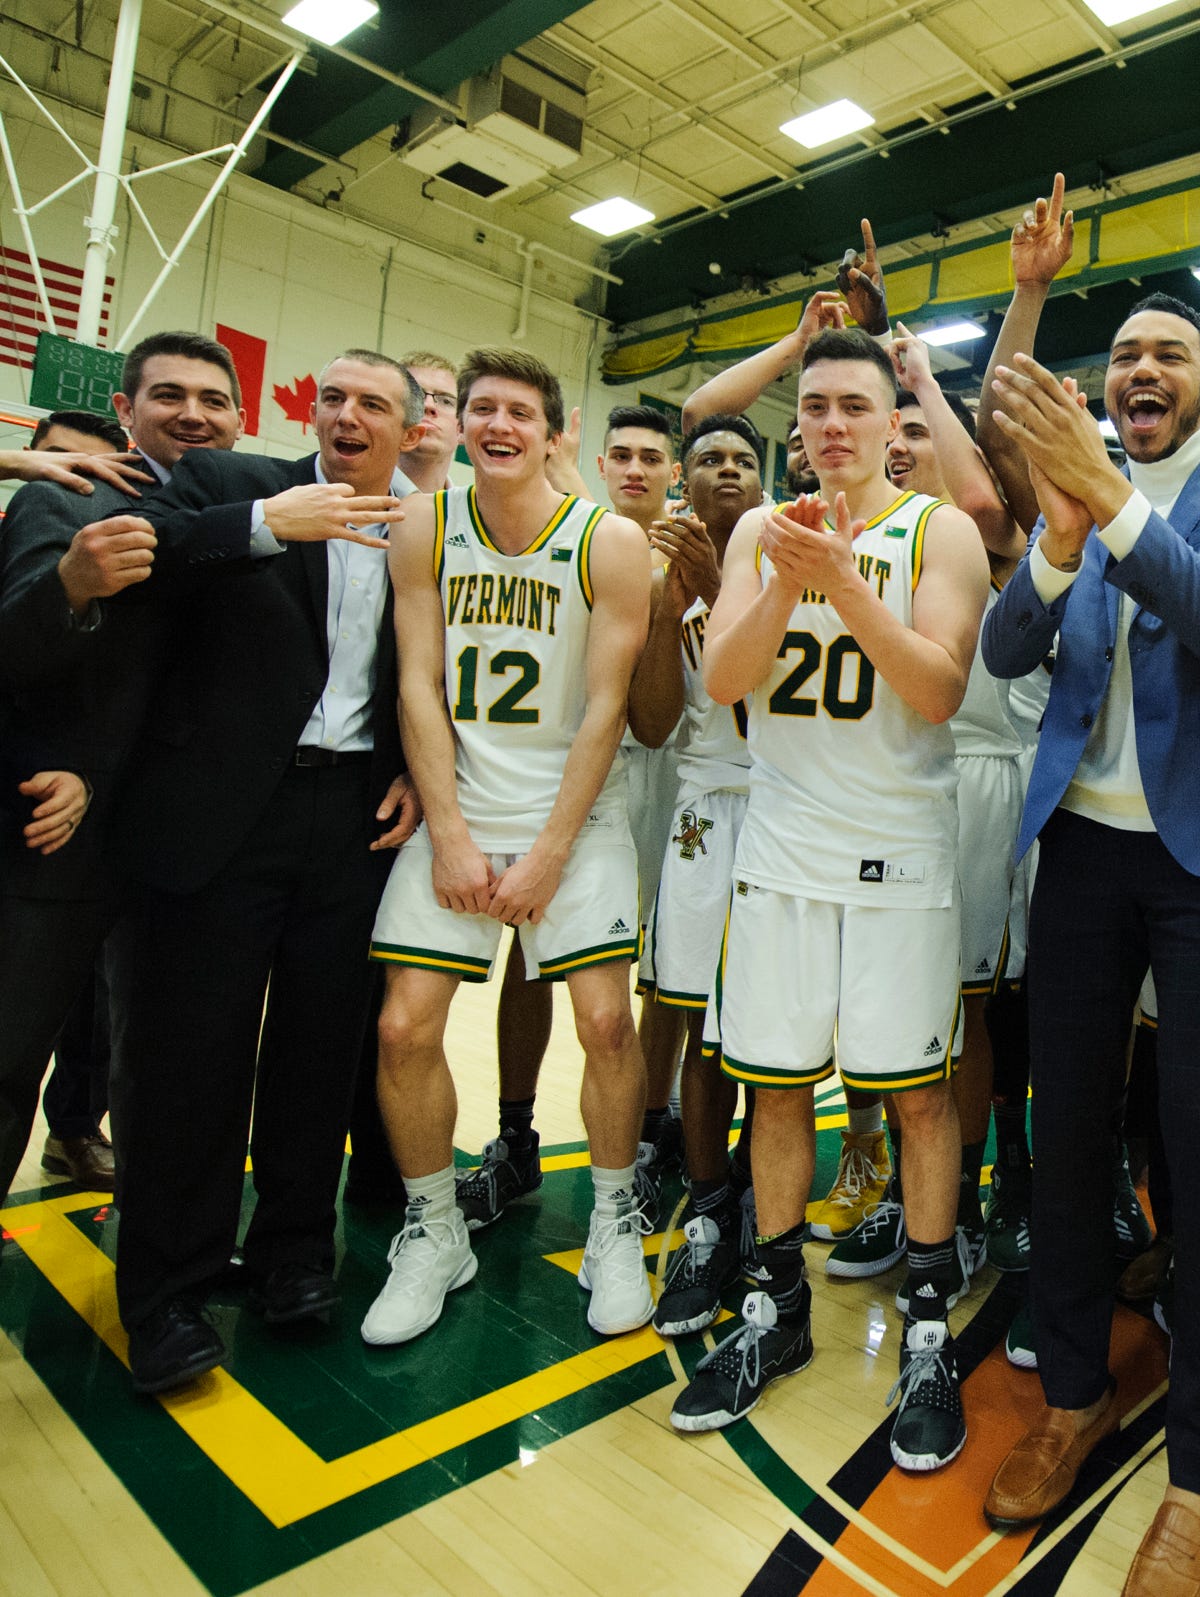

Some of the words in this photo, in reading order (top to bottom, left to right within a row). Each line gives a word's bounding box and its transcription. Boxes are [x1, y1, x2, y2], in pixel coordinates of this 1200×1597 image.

[447, 574, 561, 636] VERMONT
[452, 645, 541, 724] 12
[768, 630, 876, 721] 20
